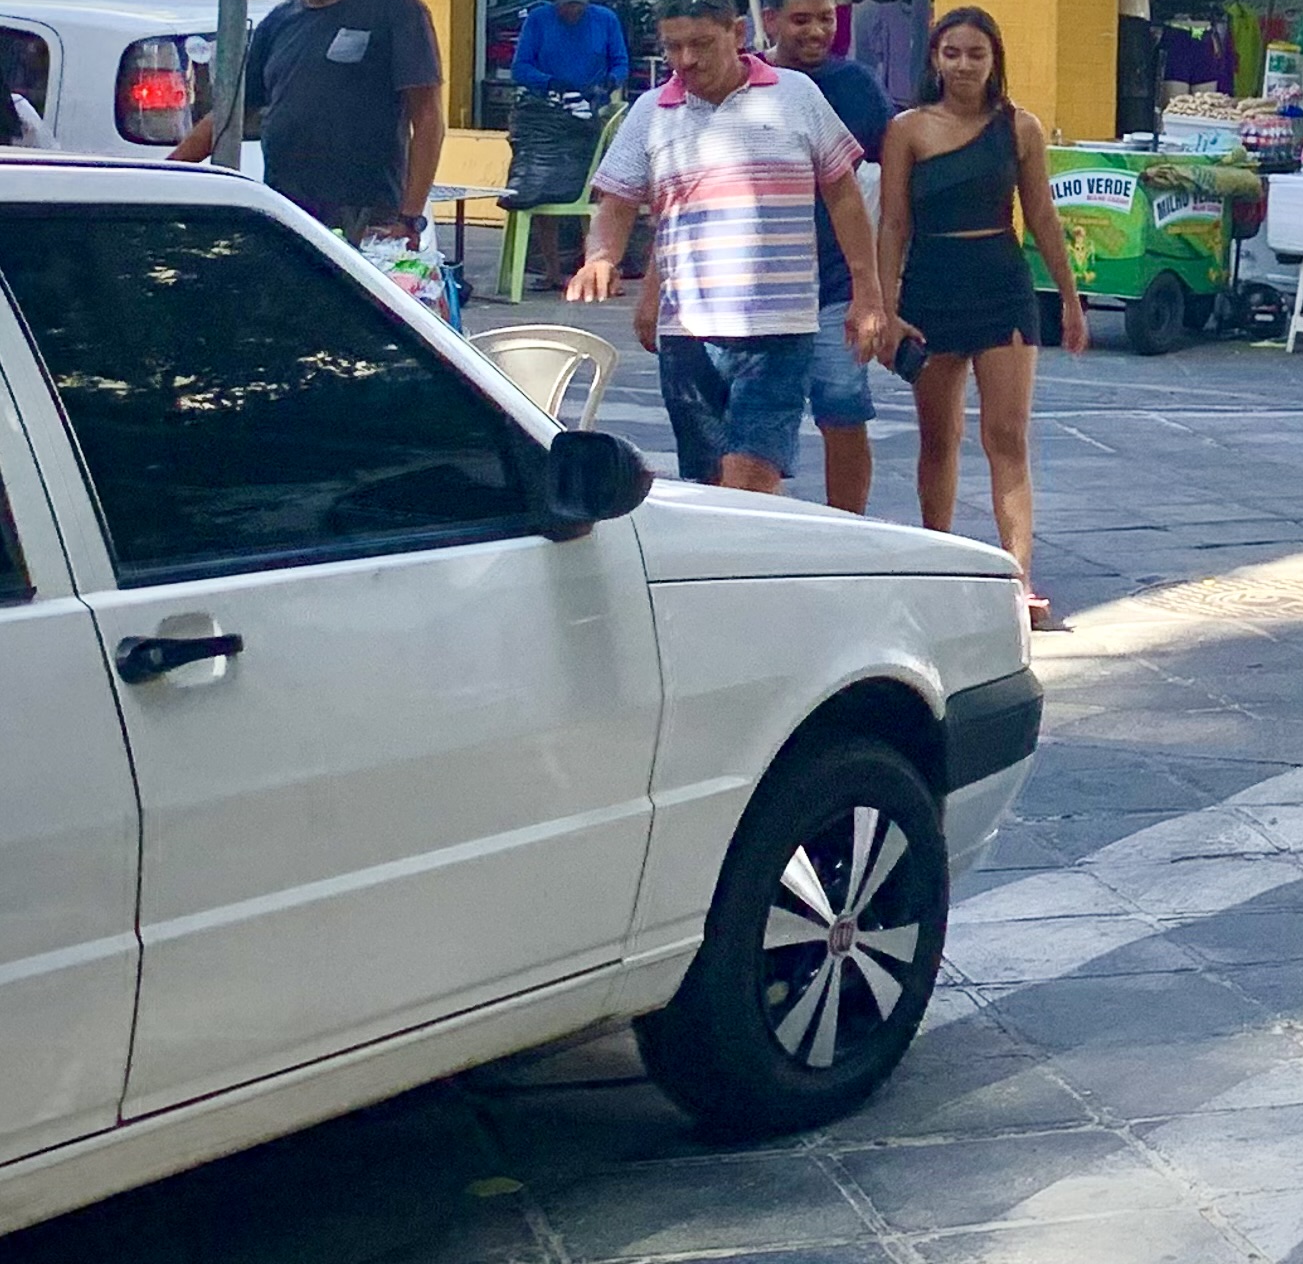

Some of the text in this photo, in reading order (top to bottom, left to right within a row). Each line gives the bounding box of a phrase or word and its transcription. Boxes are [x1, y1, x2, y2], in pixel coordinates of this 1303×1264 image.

[1050, 177, 1132, 201] ILHO VERDE
[1156, 192, 1189, 221] MILHO
